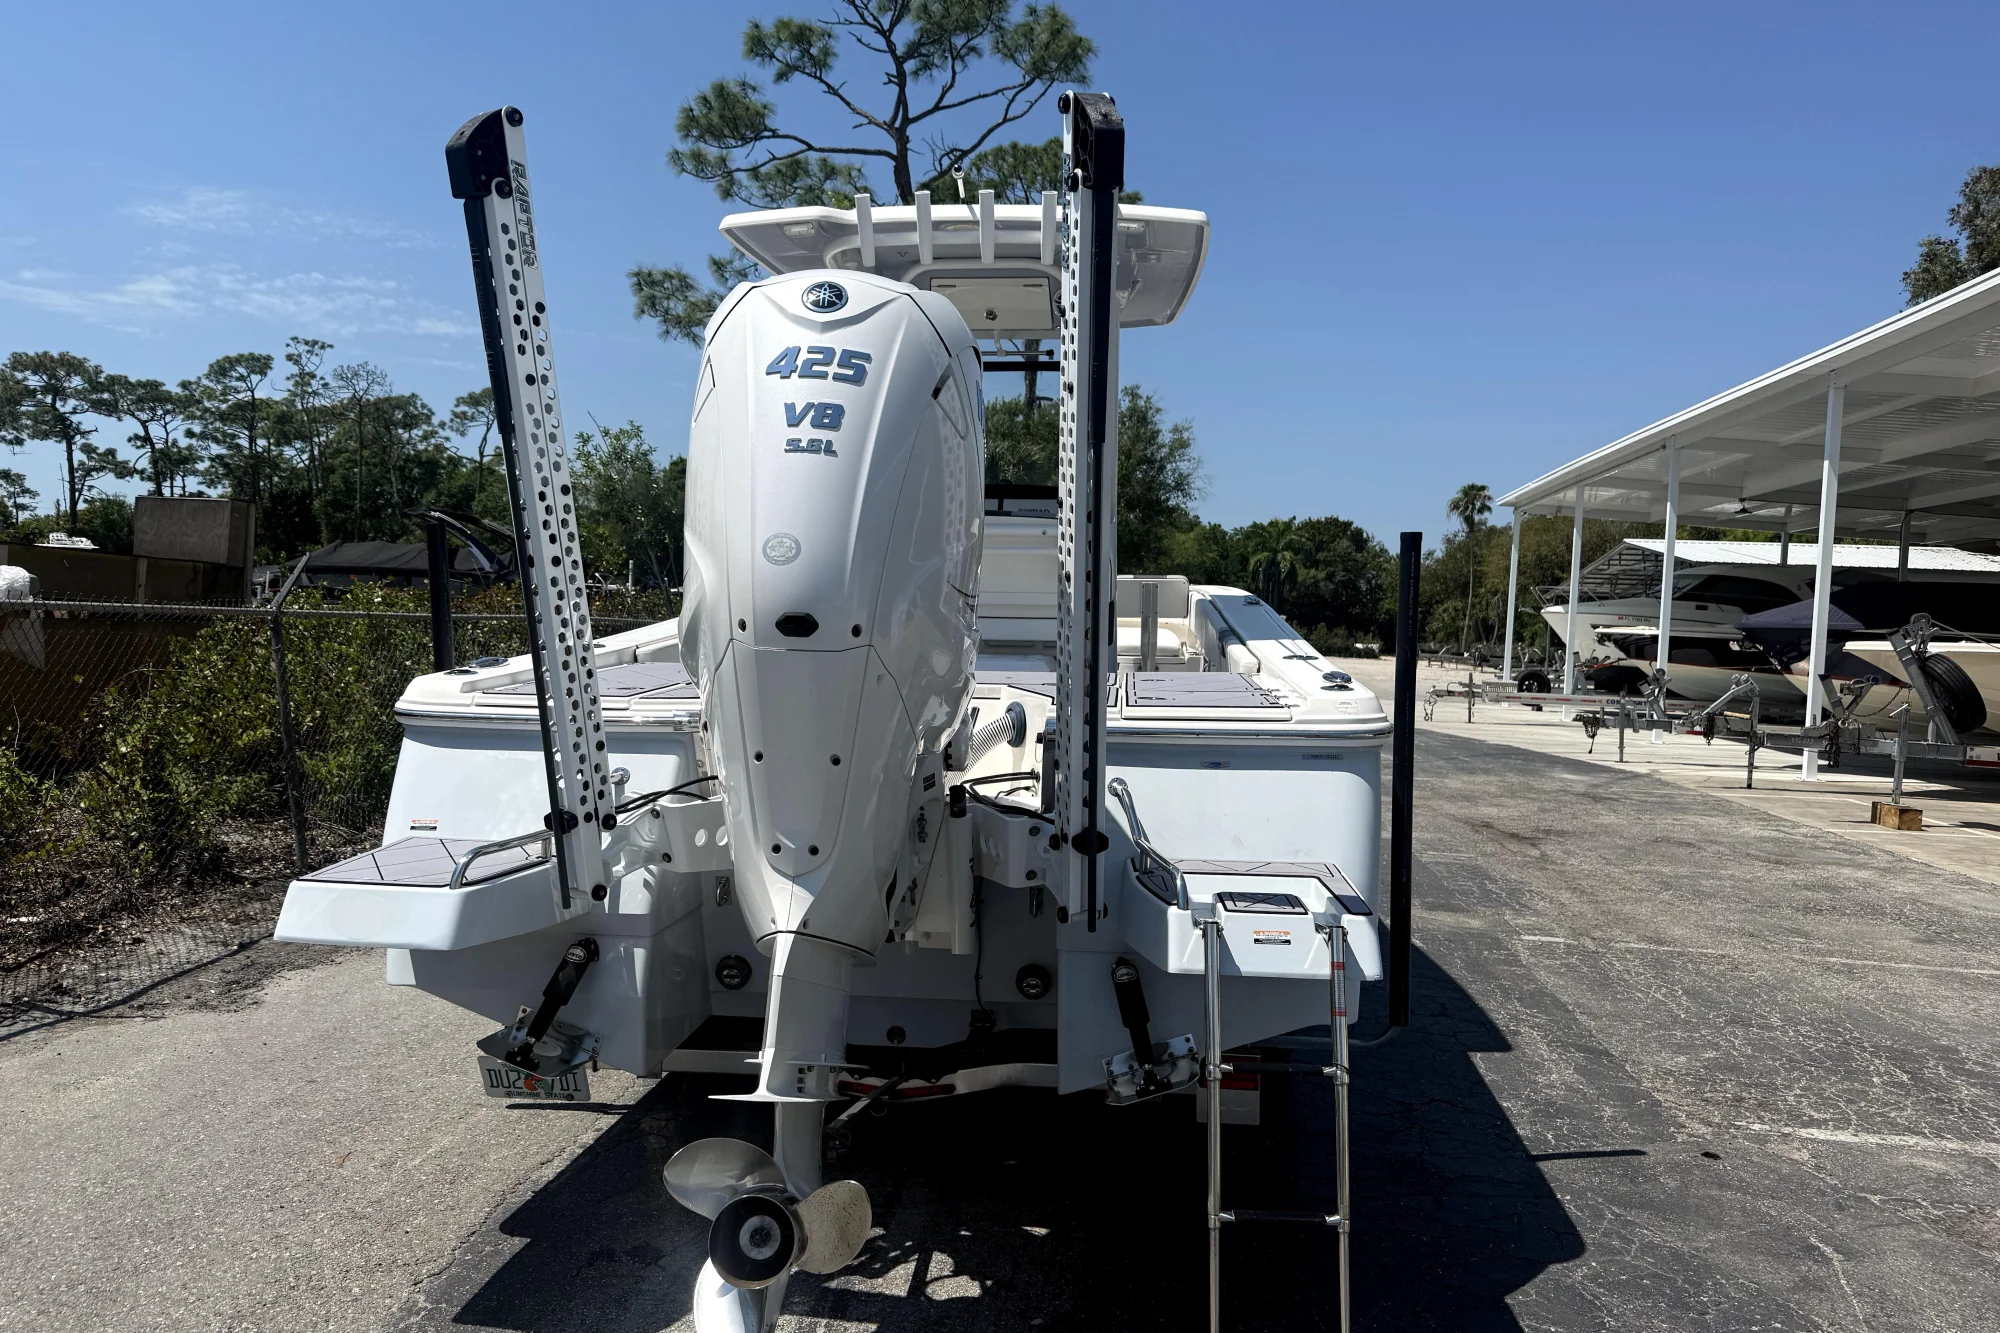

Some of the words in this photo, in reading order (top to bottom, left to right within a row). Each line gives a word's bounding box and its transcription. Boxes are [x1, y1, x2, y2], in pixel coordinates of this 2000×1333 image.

[510, 159, 538, 270] RAPTOR
[765, 345, 873, 387] 425
[783, 401, 846, 432] V8
[783, 437, 839, 458] 5.6L
